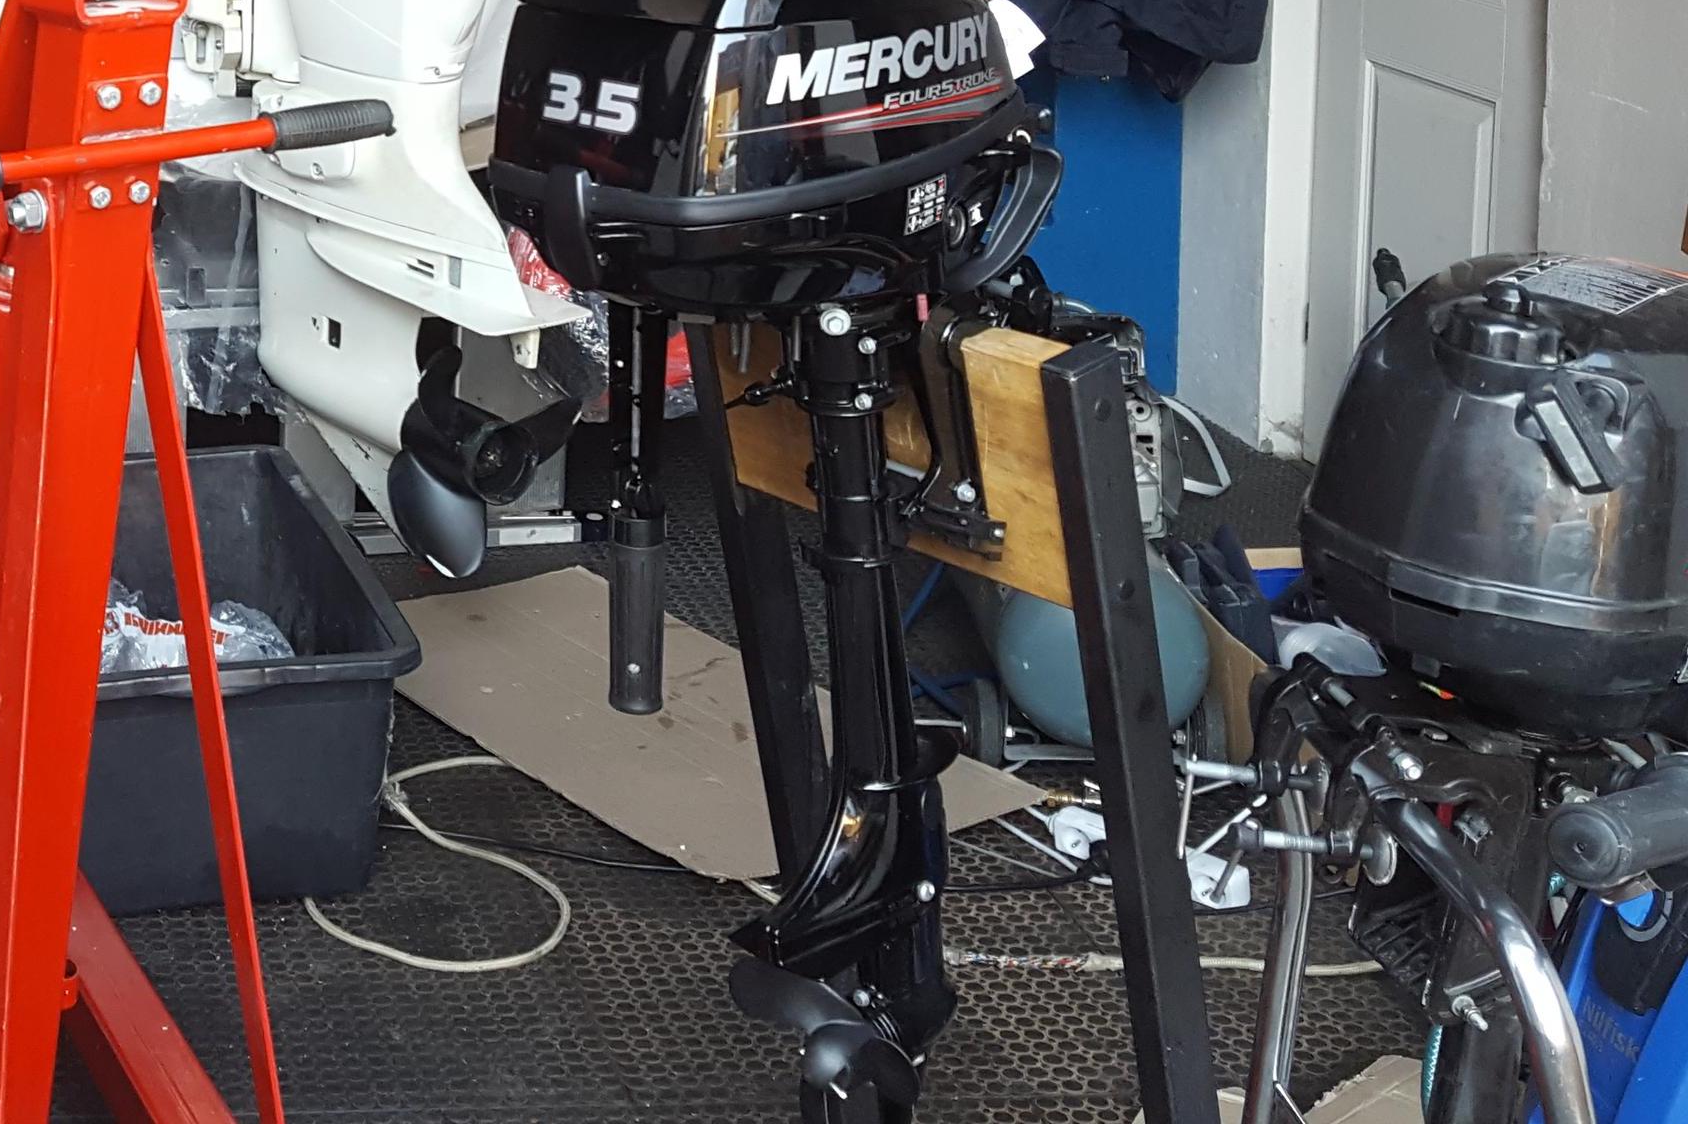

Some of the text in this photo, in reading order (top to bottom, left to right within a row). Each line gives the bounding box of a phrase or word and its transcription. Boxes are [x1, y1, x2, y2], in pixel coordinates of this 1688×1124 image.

[765, 11, 989, 106] MERCURY
[882, 67, 997, 110] FOURSTROKE
[542, 70, 640, 134] 3.5
